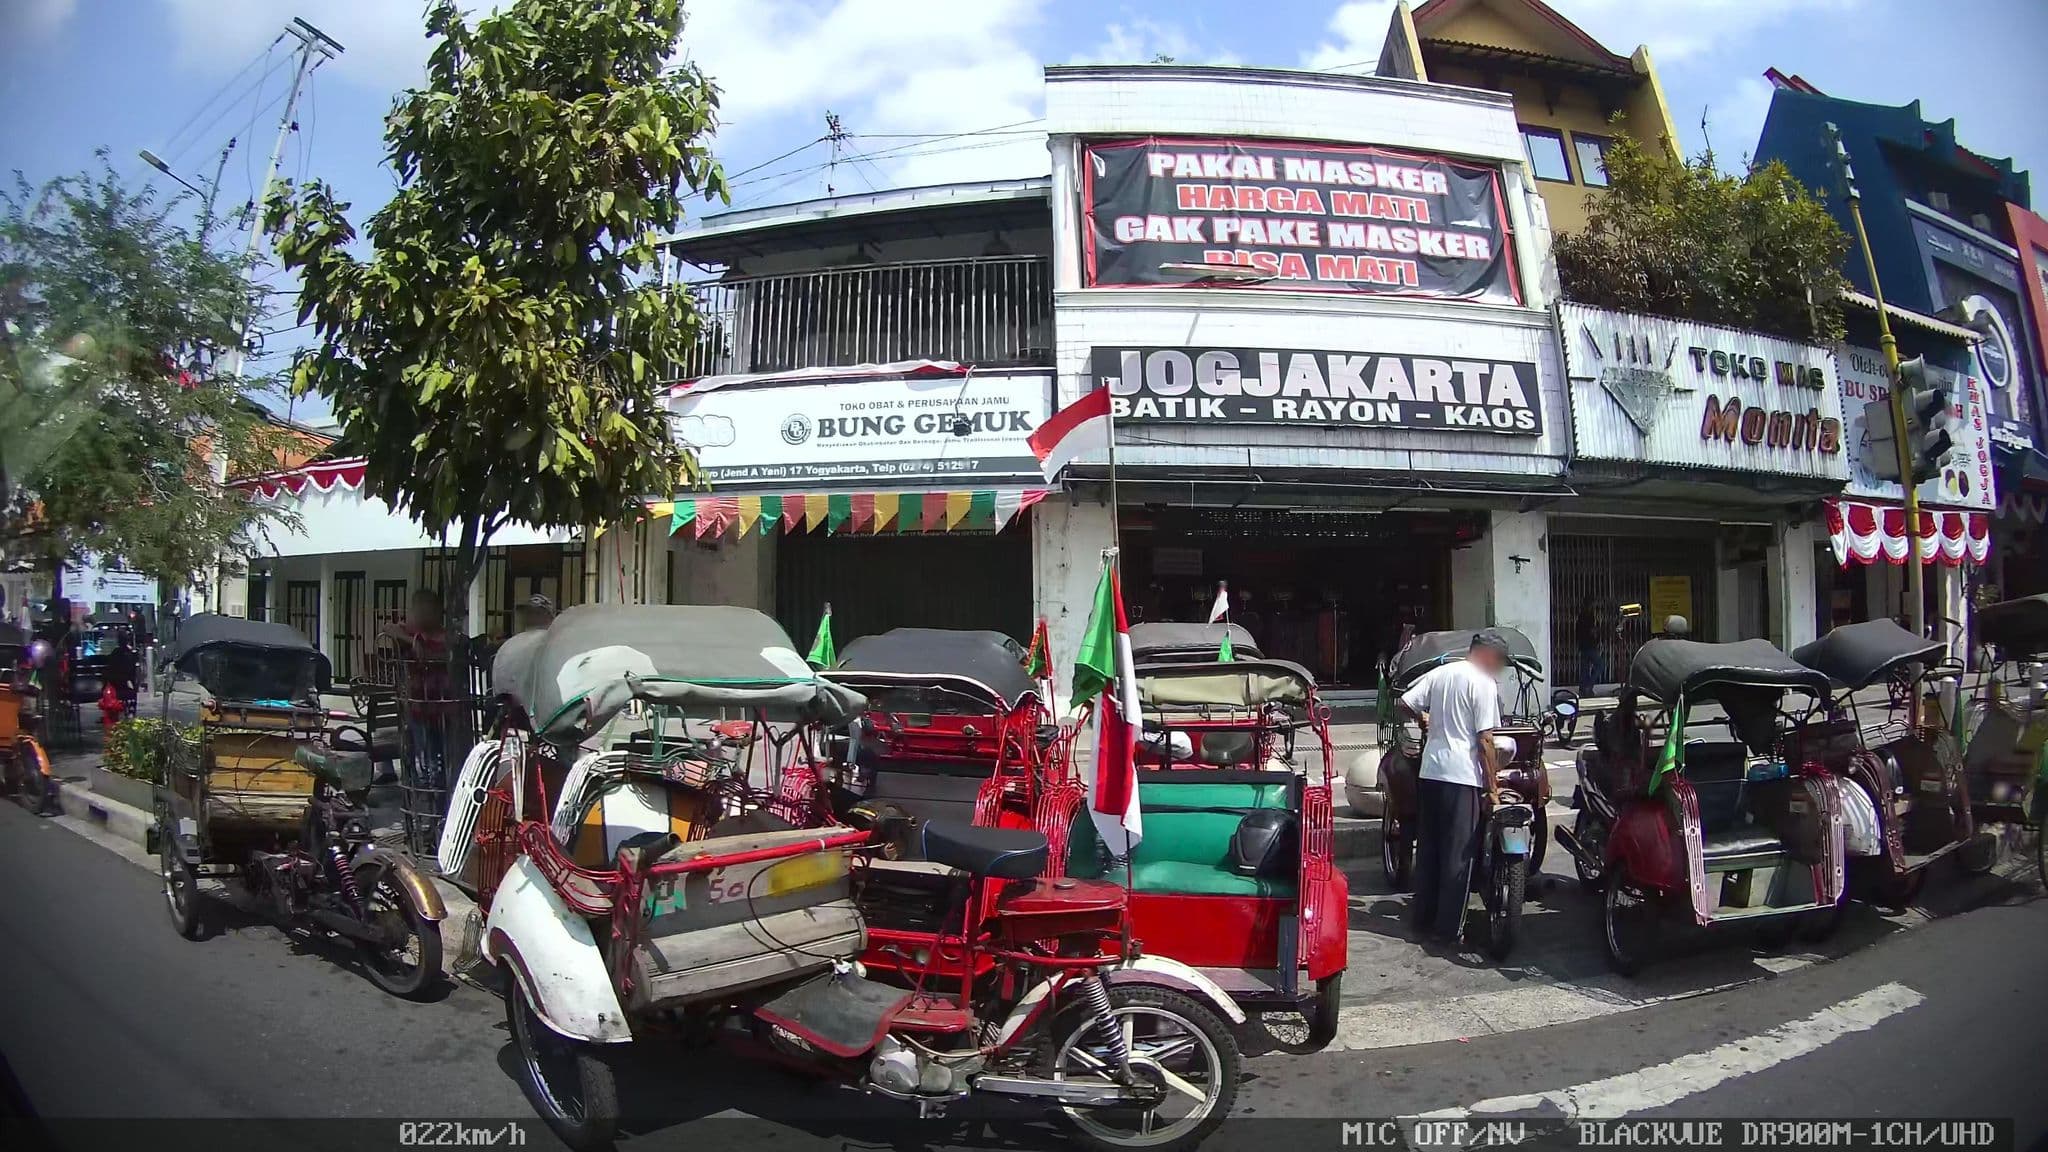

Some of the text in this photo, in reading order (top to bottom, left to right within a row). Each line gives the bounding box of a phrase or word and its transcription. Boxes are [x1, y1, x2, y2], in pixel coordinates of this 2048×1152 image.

[1148, 152, 1448, 195] PAKAI MASKER
[1177, 184, 1430, 224] HARGA MATI
[1115, 214, 1491, 260] GAK PAKE MASKER
[1316, 254, 1419, 287] MATI
[1102, 350, 1528, 408] JOGJAKARTA
[1688, 346, 1768, 381] TOKO
[840, 396, 1010, 411] TOKO OBAT & PERUSAHAAN JAMU
[1844, 380, 1865, 399] BU
[817, 415, 906, 438] BUNG
[914, 411, 1033, 434] GEMUK
[1111, 397, 1227, 418] BATIK
[1273, 399, 1400, 423] RAYON
[1444, 405, 1536, 429] KAOS
[721, 468, 748, 479] (Jend
[751, 468, 759, 477] A
[761, 466, 787, 477] Yani)
[790, 466, 802, 475] 17
[805, 463, 868, 476] Yogyakarta,
